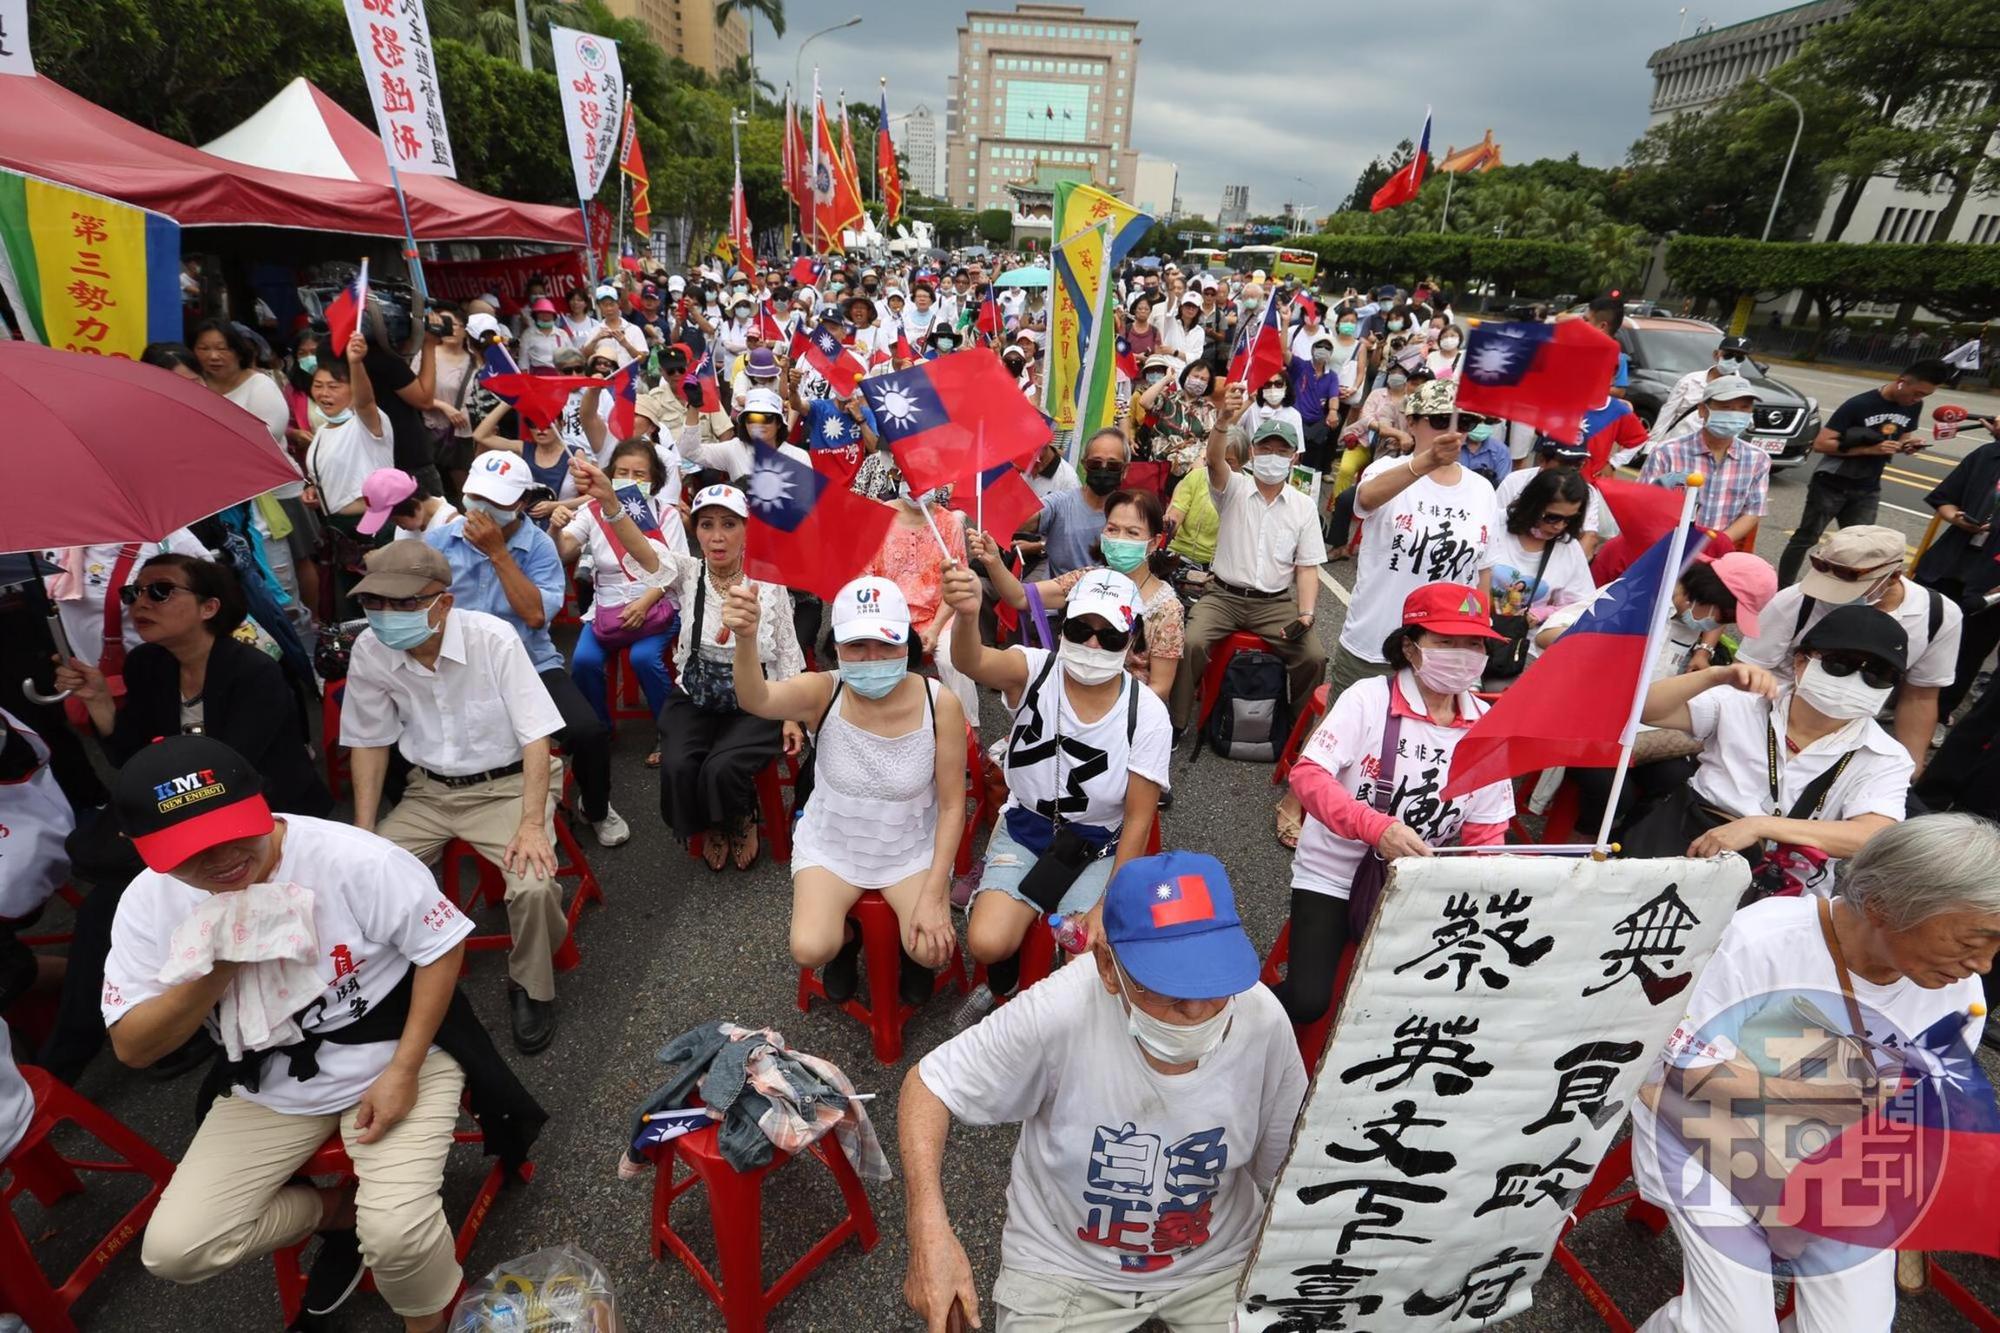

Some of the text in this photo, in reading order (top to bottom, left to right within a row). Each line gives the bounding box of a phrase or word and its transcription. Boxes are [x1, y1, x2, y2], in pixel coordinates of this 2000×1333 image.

[66, 211, 117, 342] 第三勢力
[1417, 501, 1470, 521] 是非不分
[857, 588, 880, 603] UP
[153, 769, 215, 801] KMT
[162, 785, 222, 811] NEW ENERGY
